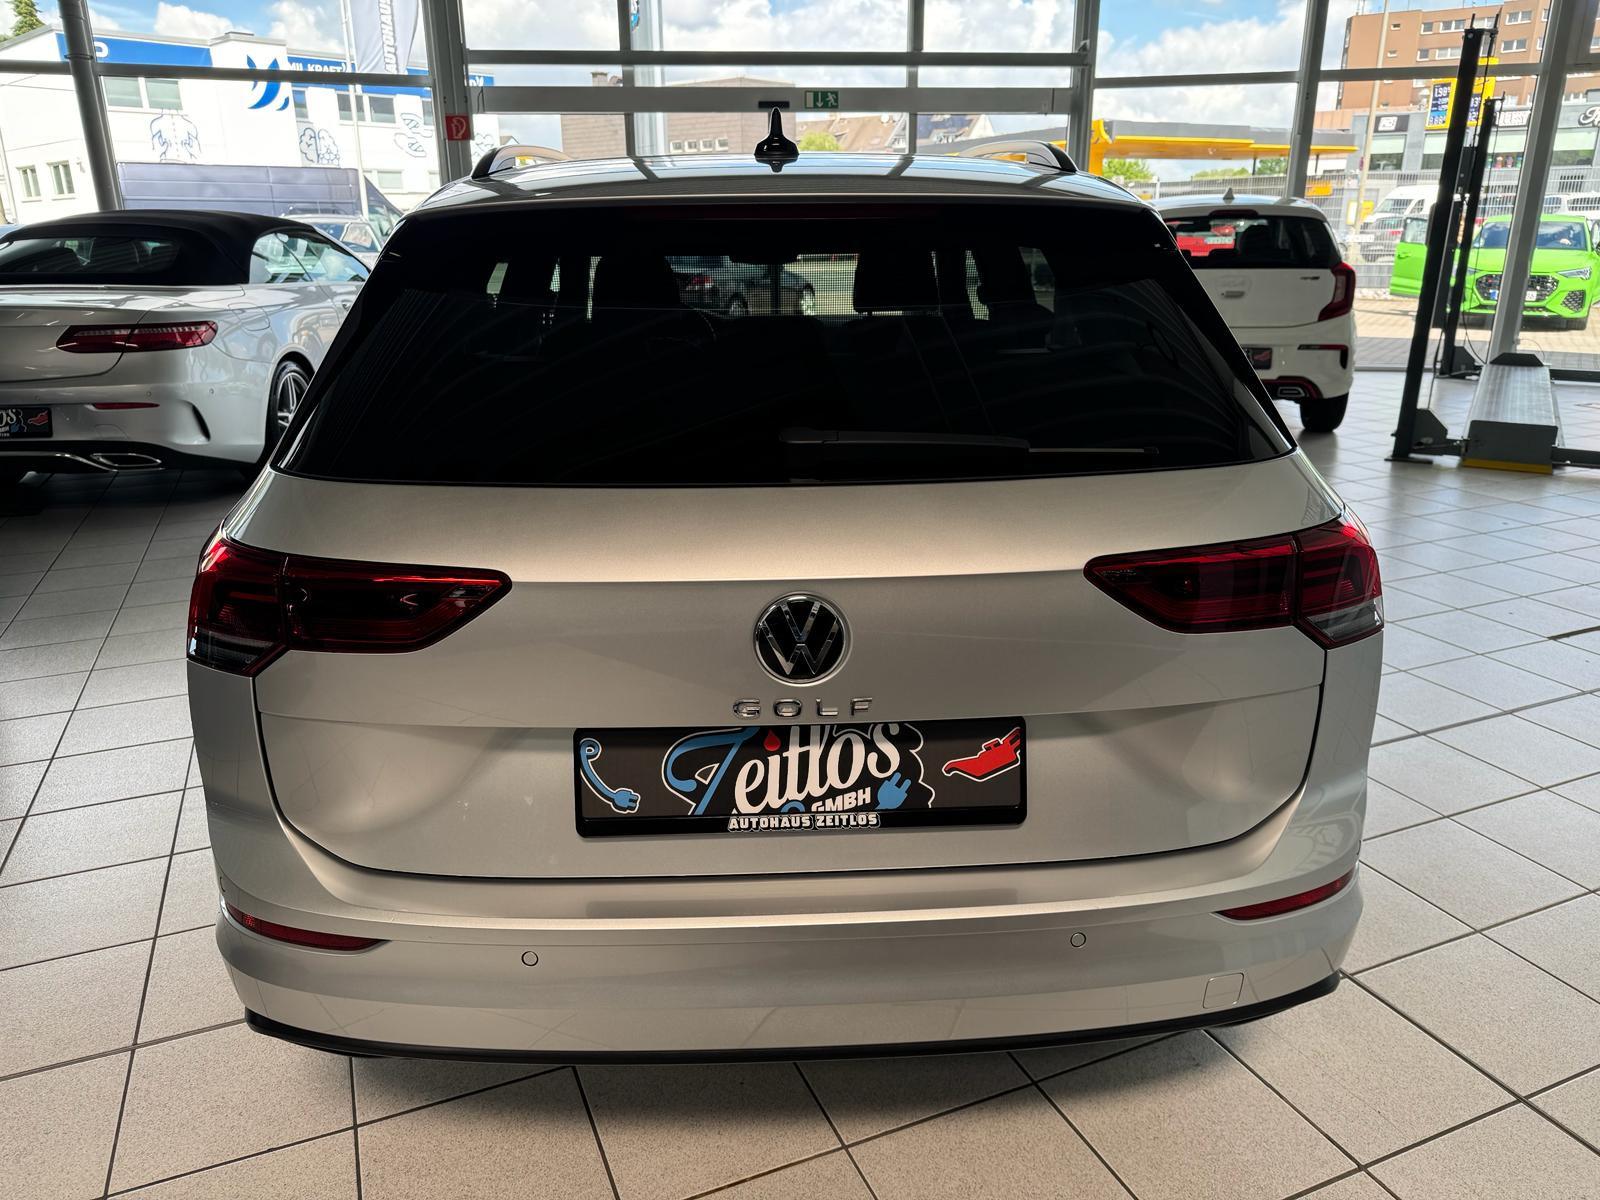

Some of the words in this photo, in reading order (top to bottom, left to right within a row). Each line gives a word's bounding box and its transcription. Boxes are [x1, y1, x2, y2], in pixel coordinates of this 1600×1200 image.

[733, 697, 873, 719] GOLF
[729, 815, 811, 830] AUTOHAUS
[815, 813, 878, 828] ZEITLOS
